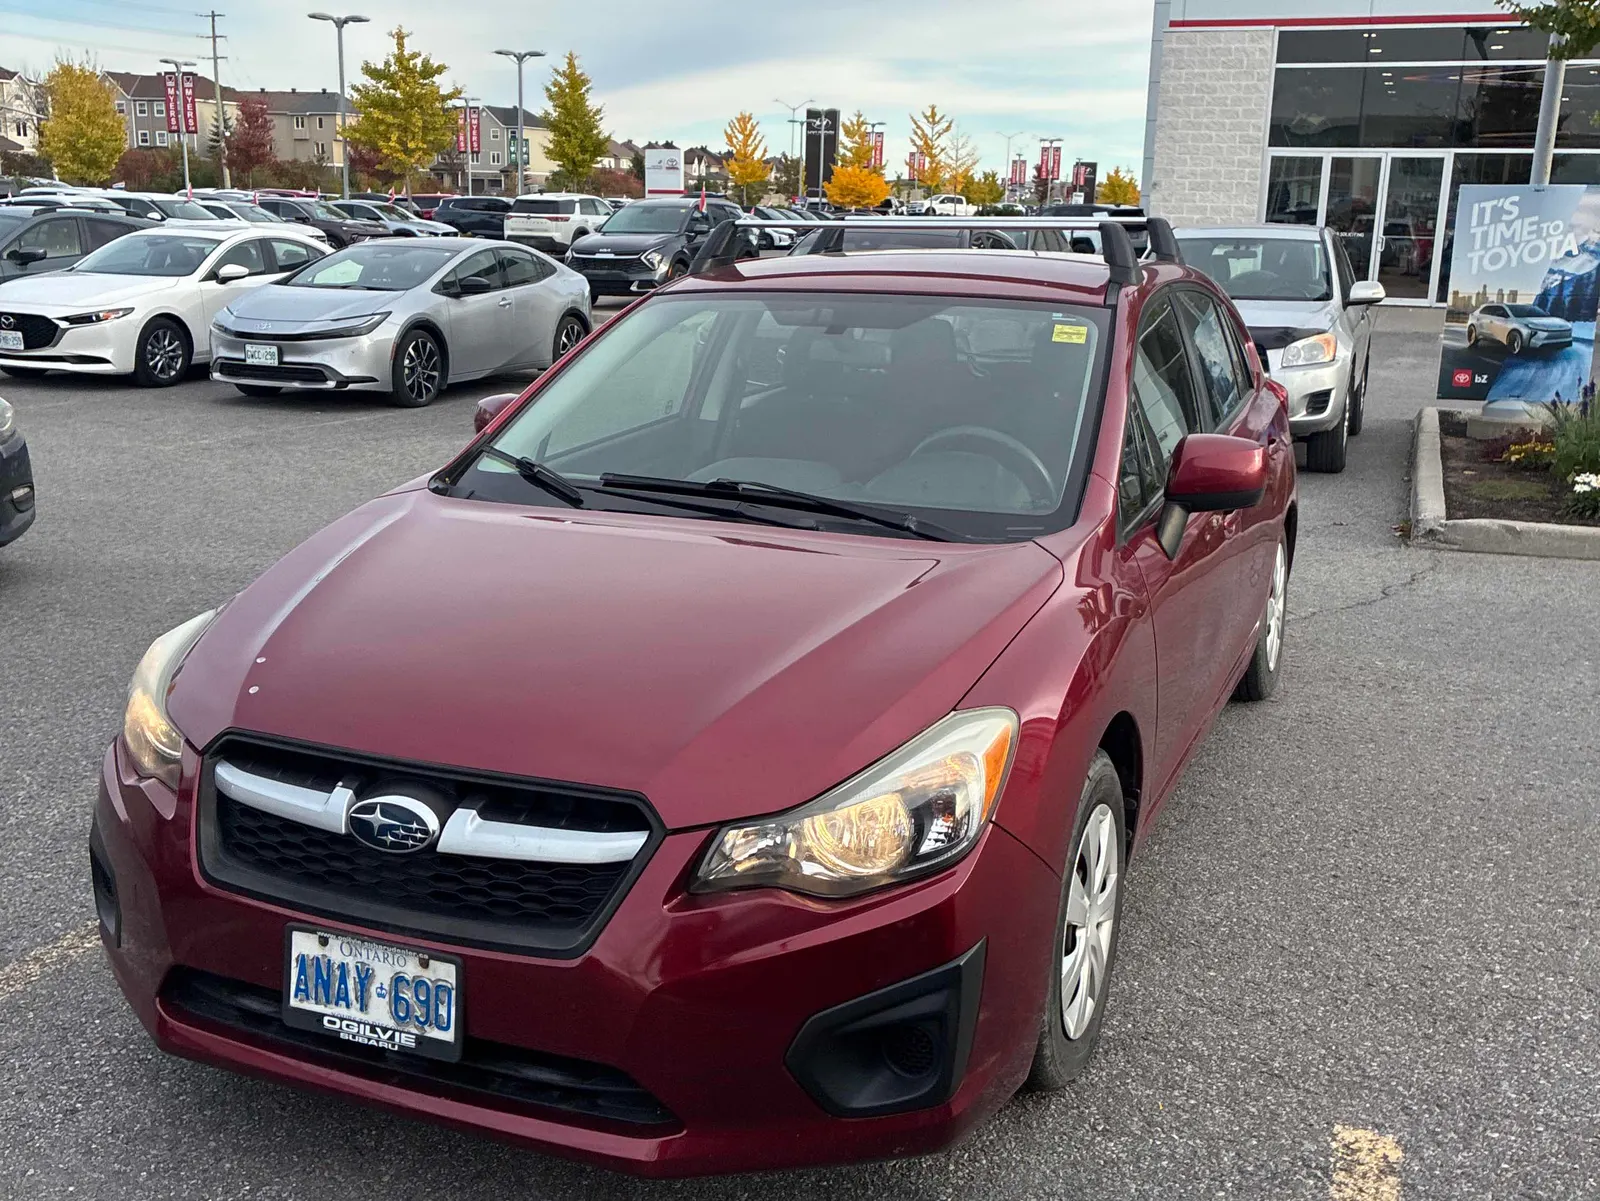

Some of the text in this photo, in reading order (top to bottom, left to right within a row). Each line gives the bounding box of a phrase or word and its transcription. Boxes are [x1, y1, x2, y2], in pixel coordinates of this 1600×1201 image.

[167, 87, 176, 125] MYERS
[185, 88, 194, 126] MYERS
[1471, 195, 1520, 227] IT'S
[1470, 215, 1564, 250] TIME TO
[1467, 232, 1579, 275] TOYOTA
[293, 953, 453, 1032] ANAY 690
[323, 1015, 416, 1044] OGILVIE
[339, 1031, 398, 1050] SUBARU
